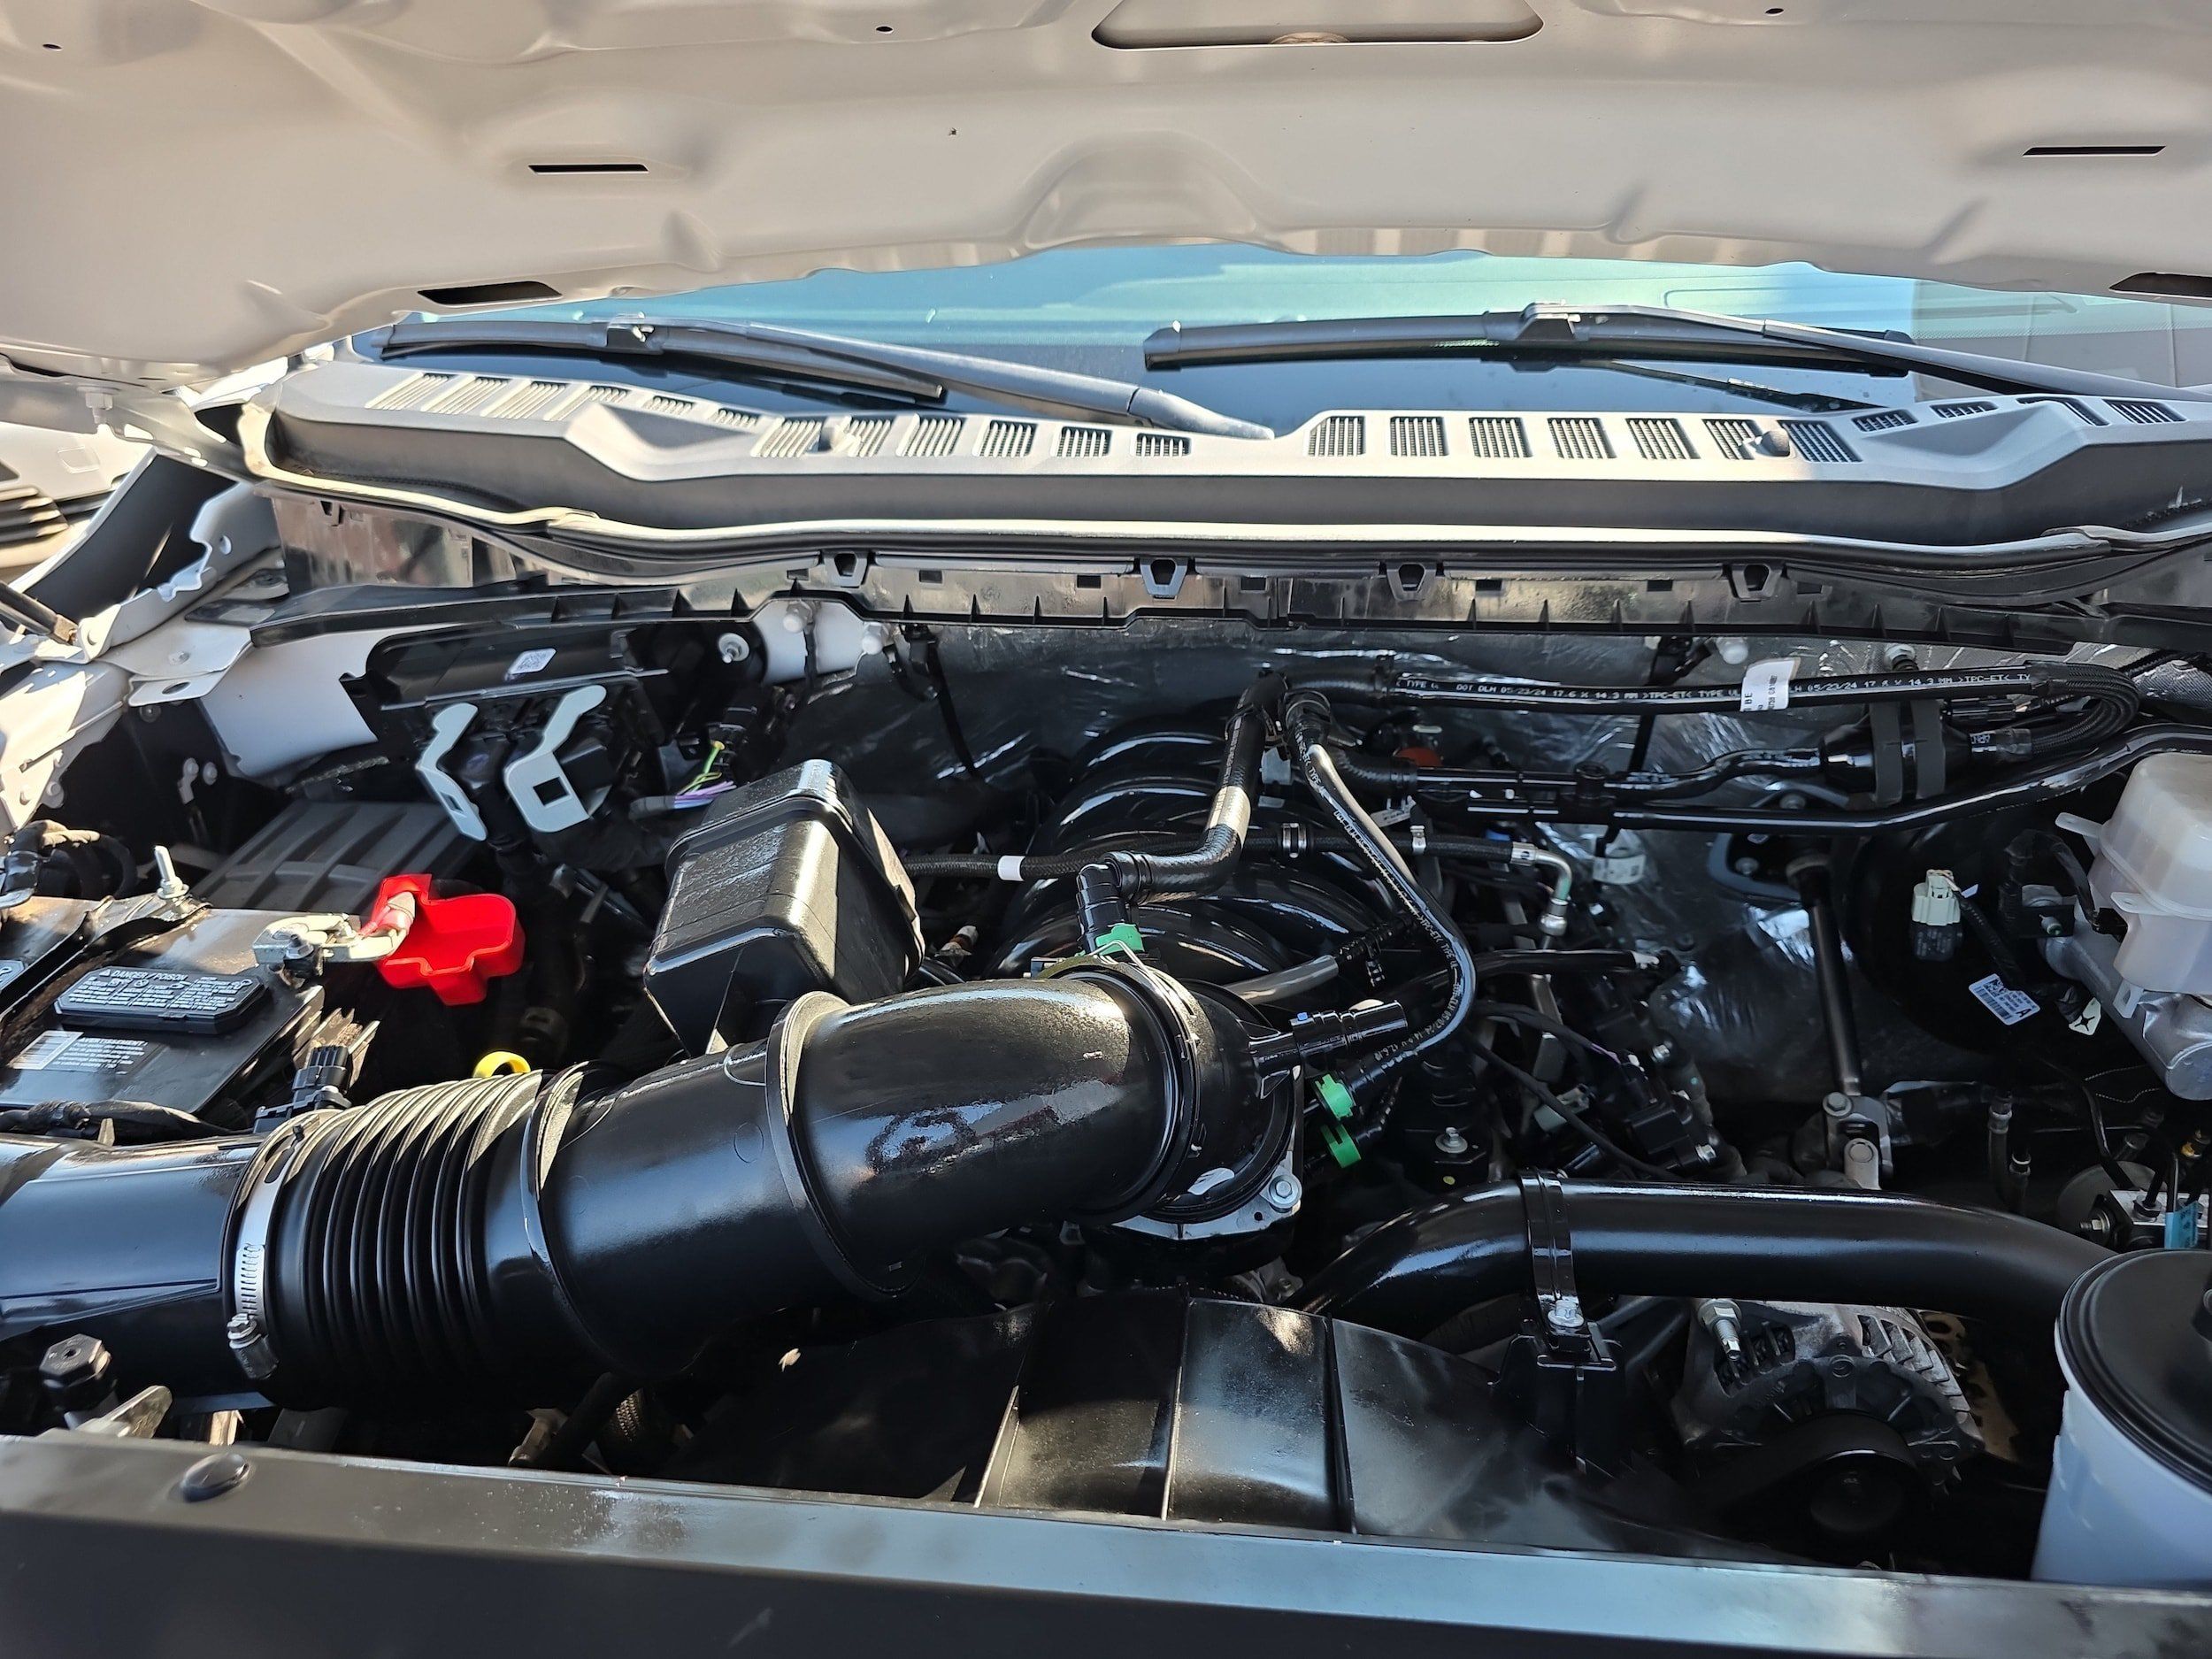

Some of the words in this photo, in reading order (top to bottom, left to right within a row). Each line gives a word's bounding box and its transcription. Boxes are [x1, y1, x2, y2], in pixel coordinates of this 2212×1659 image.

[111, 970, 149, 979] DANGER
[153, 972, 188, 981] POISON
[2015, 1008, 2032, 1018] A
